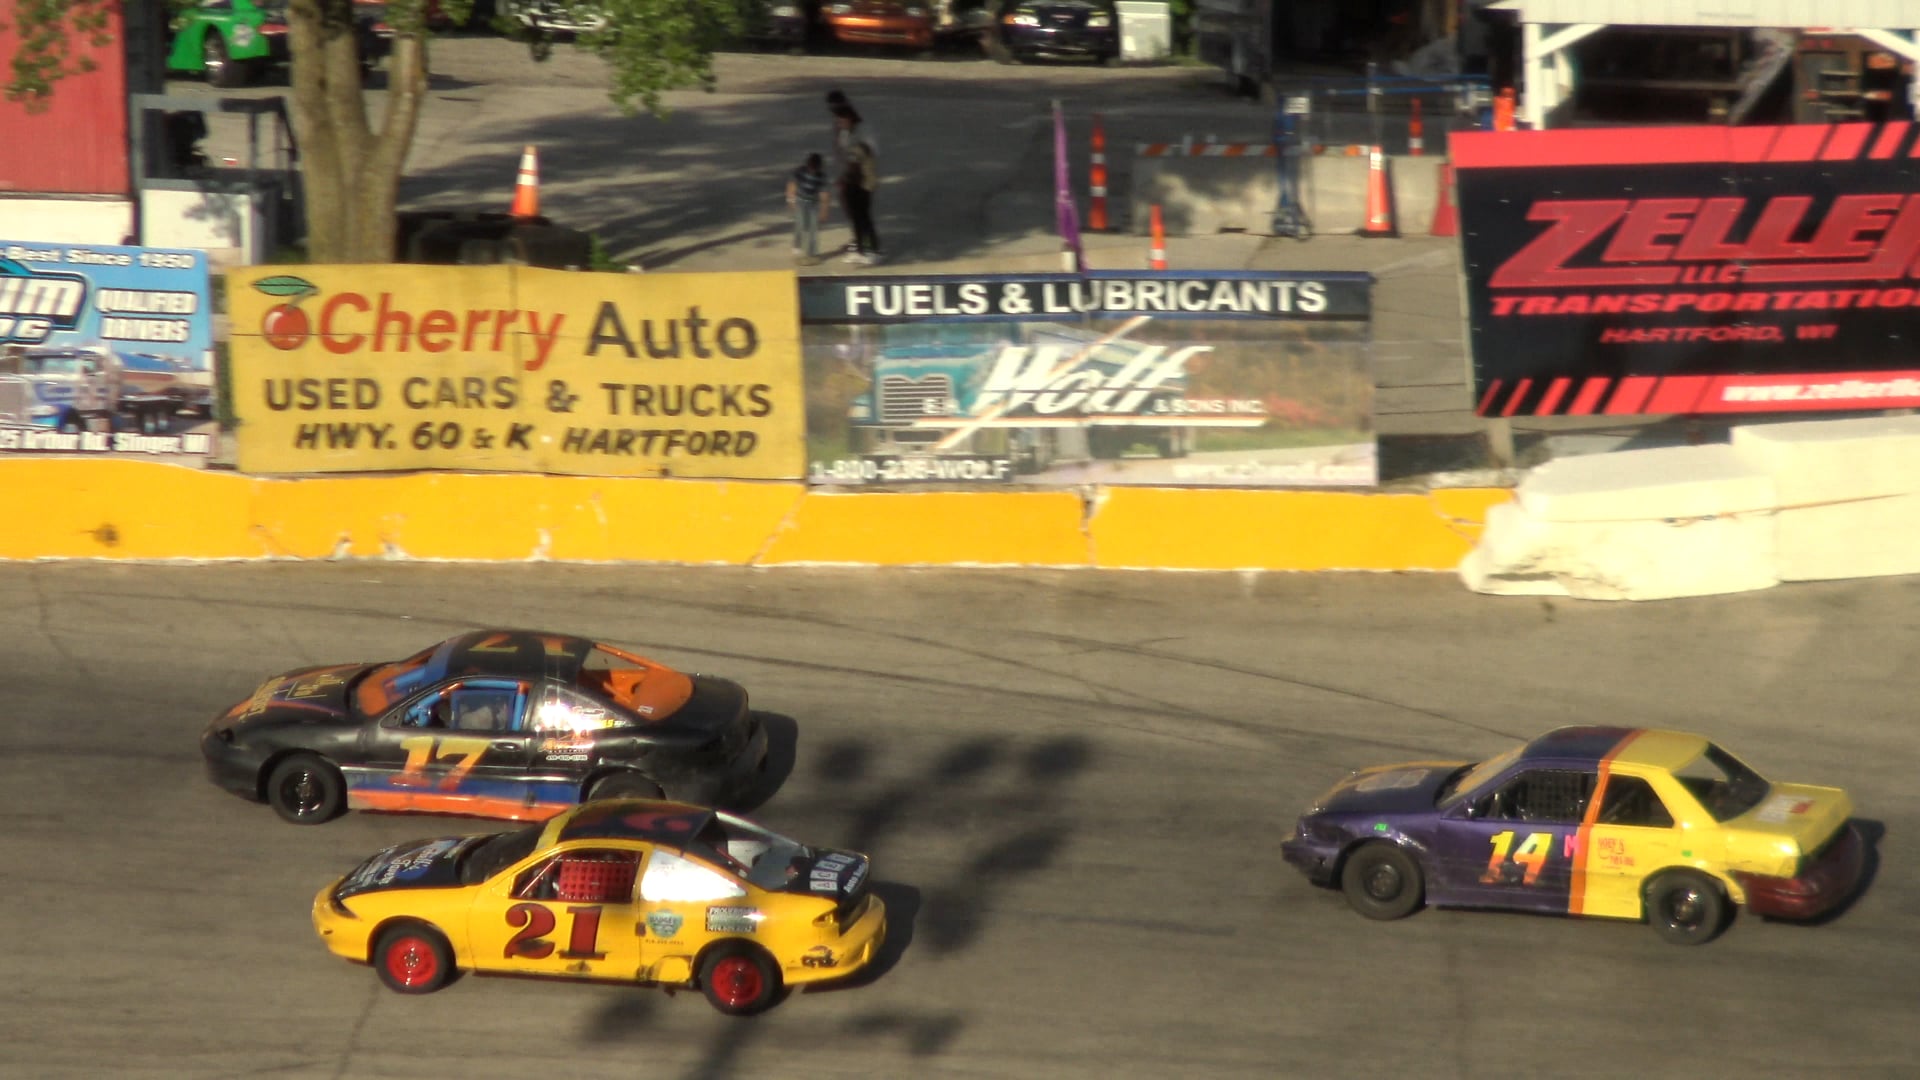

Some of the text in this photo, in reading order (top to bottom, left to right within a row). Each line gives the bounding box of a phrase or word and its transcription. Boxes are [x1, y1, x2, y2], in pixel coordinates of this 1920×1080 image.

[66, 248, 132, 266] Since
[138, 252, 196, 269] 1950
[1680, 266, 1743, 285] LLC
[845, 280, 1328, 316] FUELS & LUBRICANTS
[319, 292, 759, 371] Cherry Auto
[1796, 325, 1838, 340] WI
[264, 376, 772, 417] USED CARS & TRUCKS
[968, 345, 1215, 414] Wolf
[1171, 400, 1226, 413] SONS
[294, 421, 758, 457] HWY. 60 & K HARTFORD
[388, 736, 492, 792] 17
[1479, 831, 1552, 885] 14
[503, 902, 609, 961] 21
